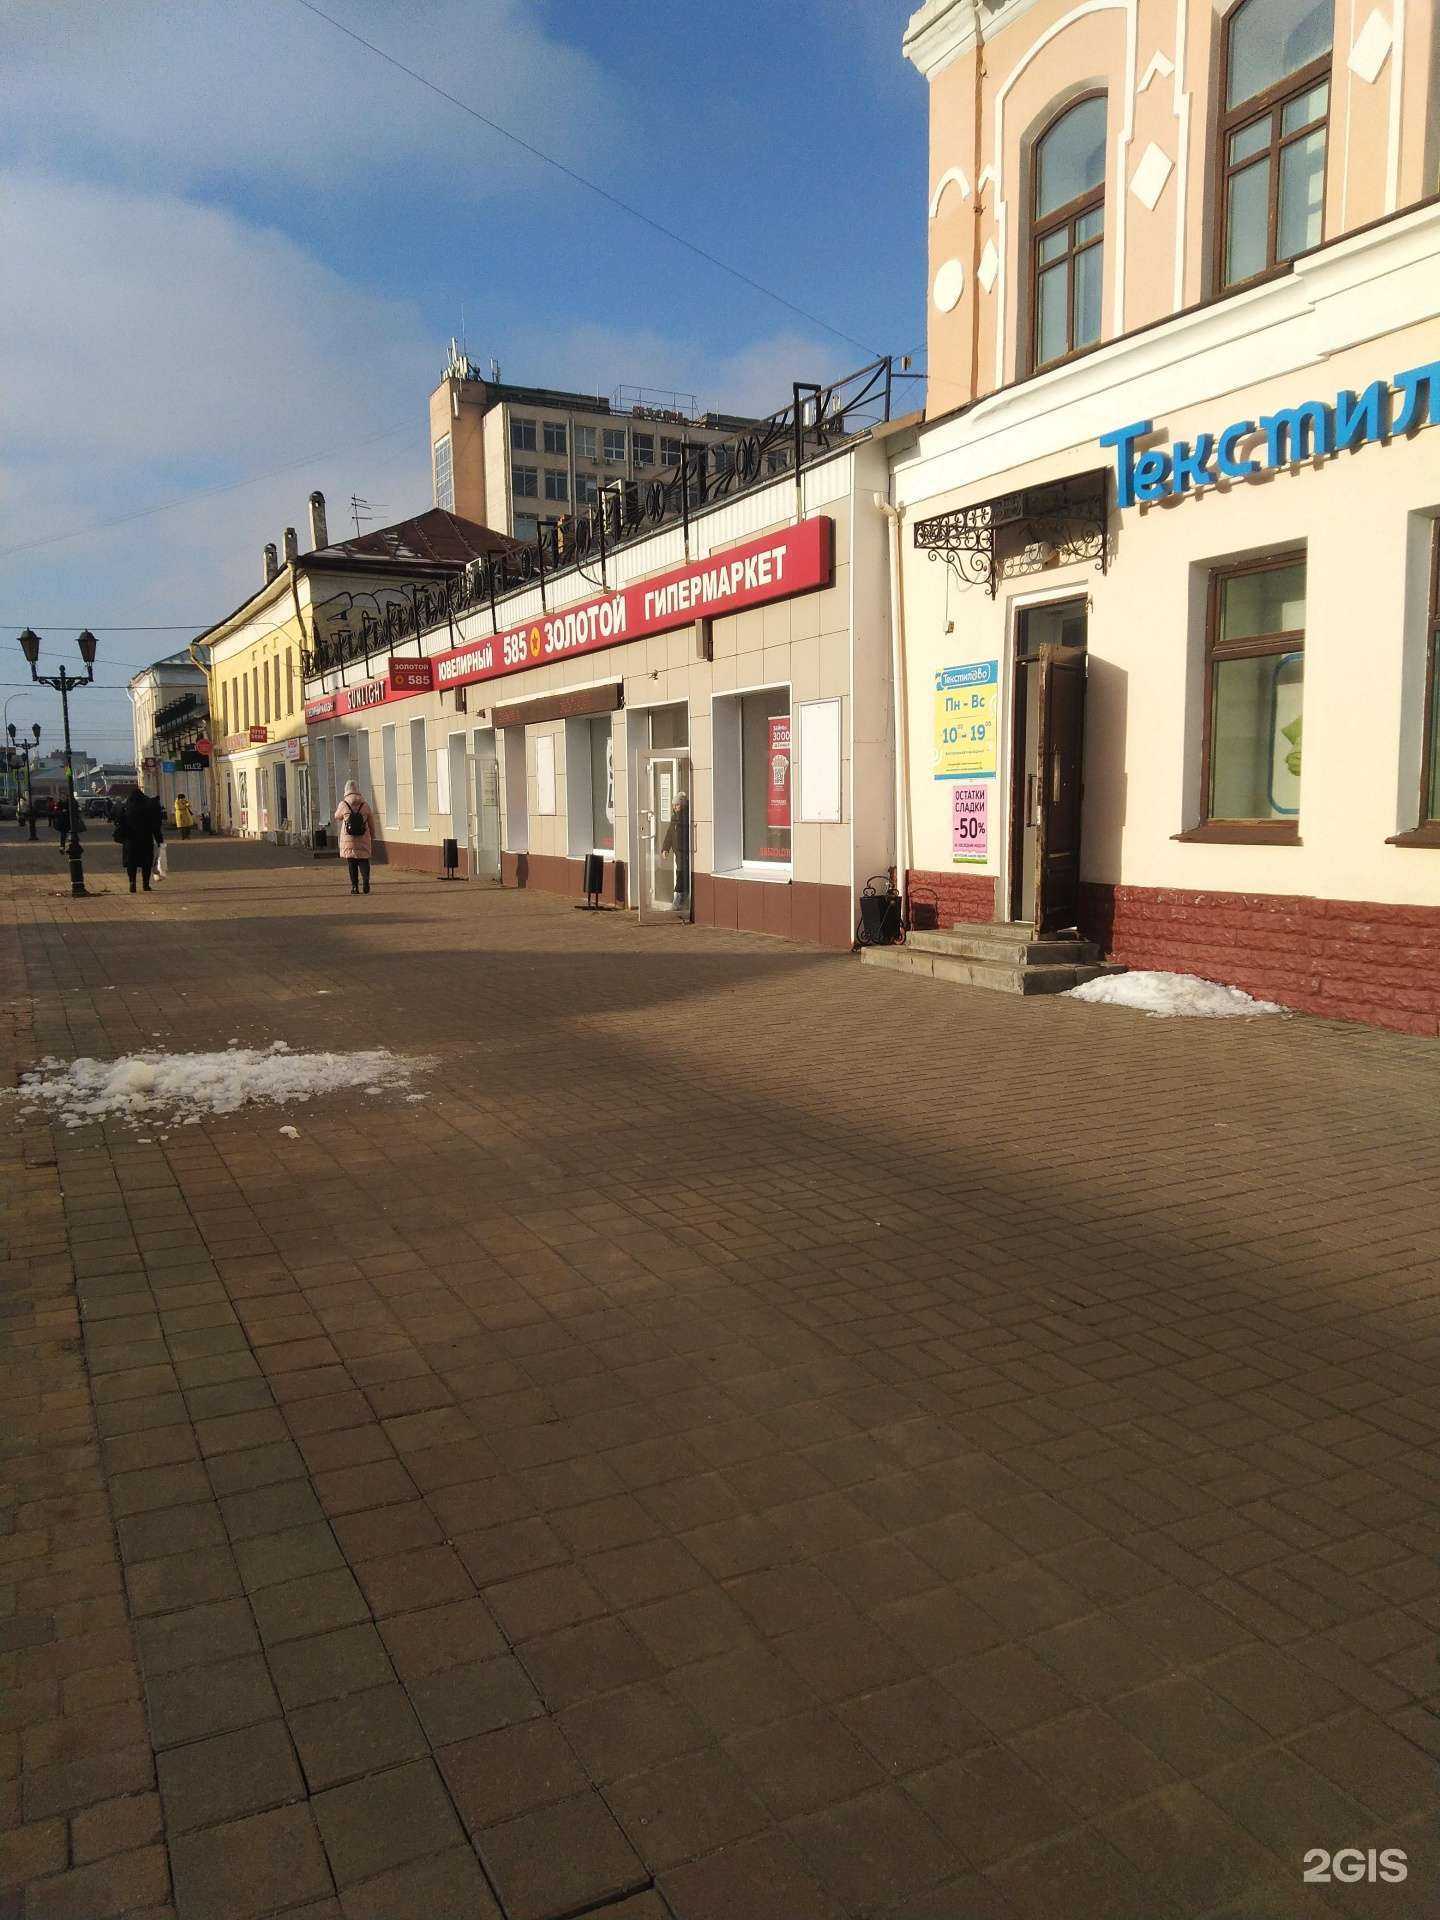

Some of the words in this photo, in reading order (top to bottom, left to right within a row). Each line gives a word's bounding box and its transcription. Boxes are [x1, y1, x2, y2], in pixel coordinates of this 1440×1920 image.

[437, 643, 494, 681] ЮВЕЛИРНЫЙ
[503, 630, 528, 666] 585
[543, 595, 627, 654] ЗОЛОТОЙ
[643, 545, 788, 621] ГИПЕРМАРКЕТ
[407, 675, 431, 685] 585
[346, 681, 387, 709] SUNLIGHT
[971, 694, 986, 709] Вс
[955, 790, 985, 801] ОСТАТКИ
